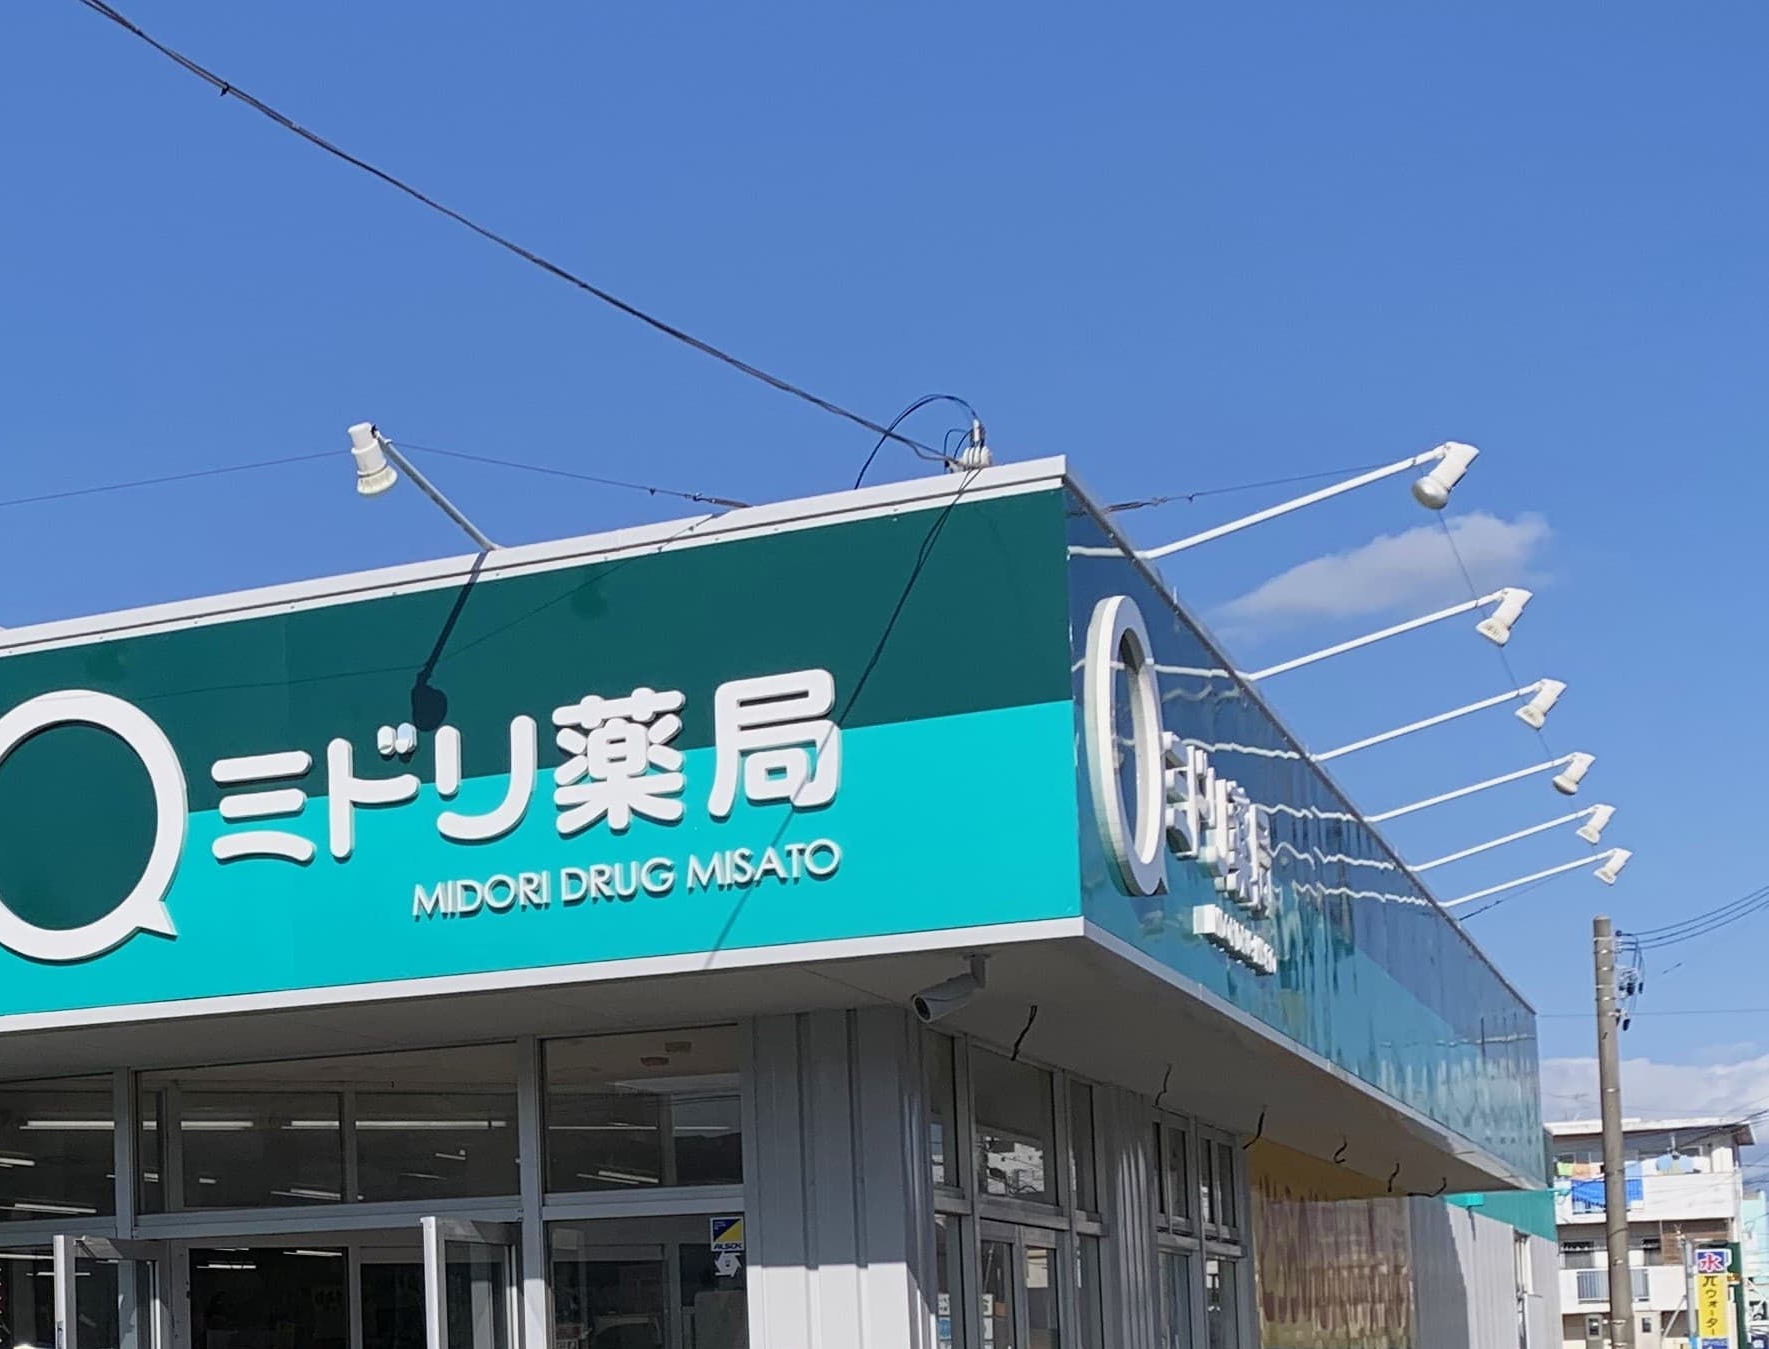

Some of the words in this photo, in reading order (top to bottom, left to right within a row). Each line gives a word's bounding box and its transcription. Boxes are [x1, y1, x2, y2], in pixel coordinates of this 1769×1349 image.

[211, 669, 842, 863] ミドリ薬局
[412, 870, 551, 921] MIDORI
[560, 856, 675, 903] DRUG
[686, 838, 841, 892] MISATO
[713, 1242, 743, 1250] ALSOK
[1698, 1251, 1723, 1273] 水
